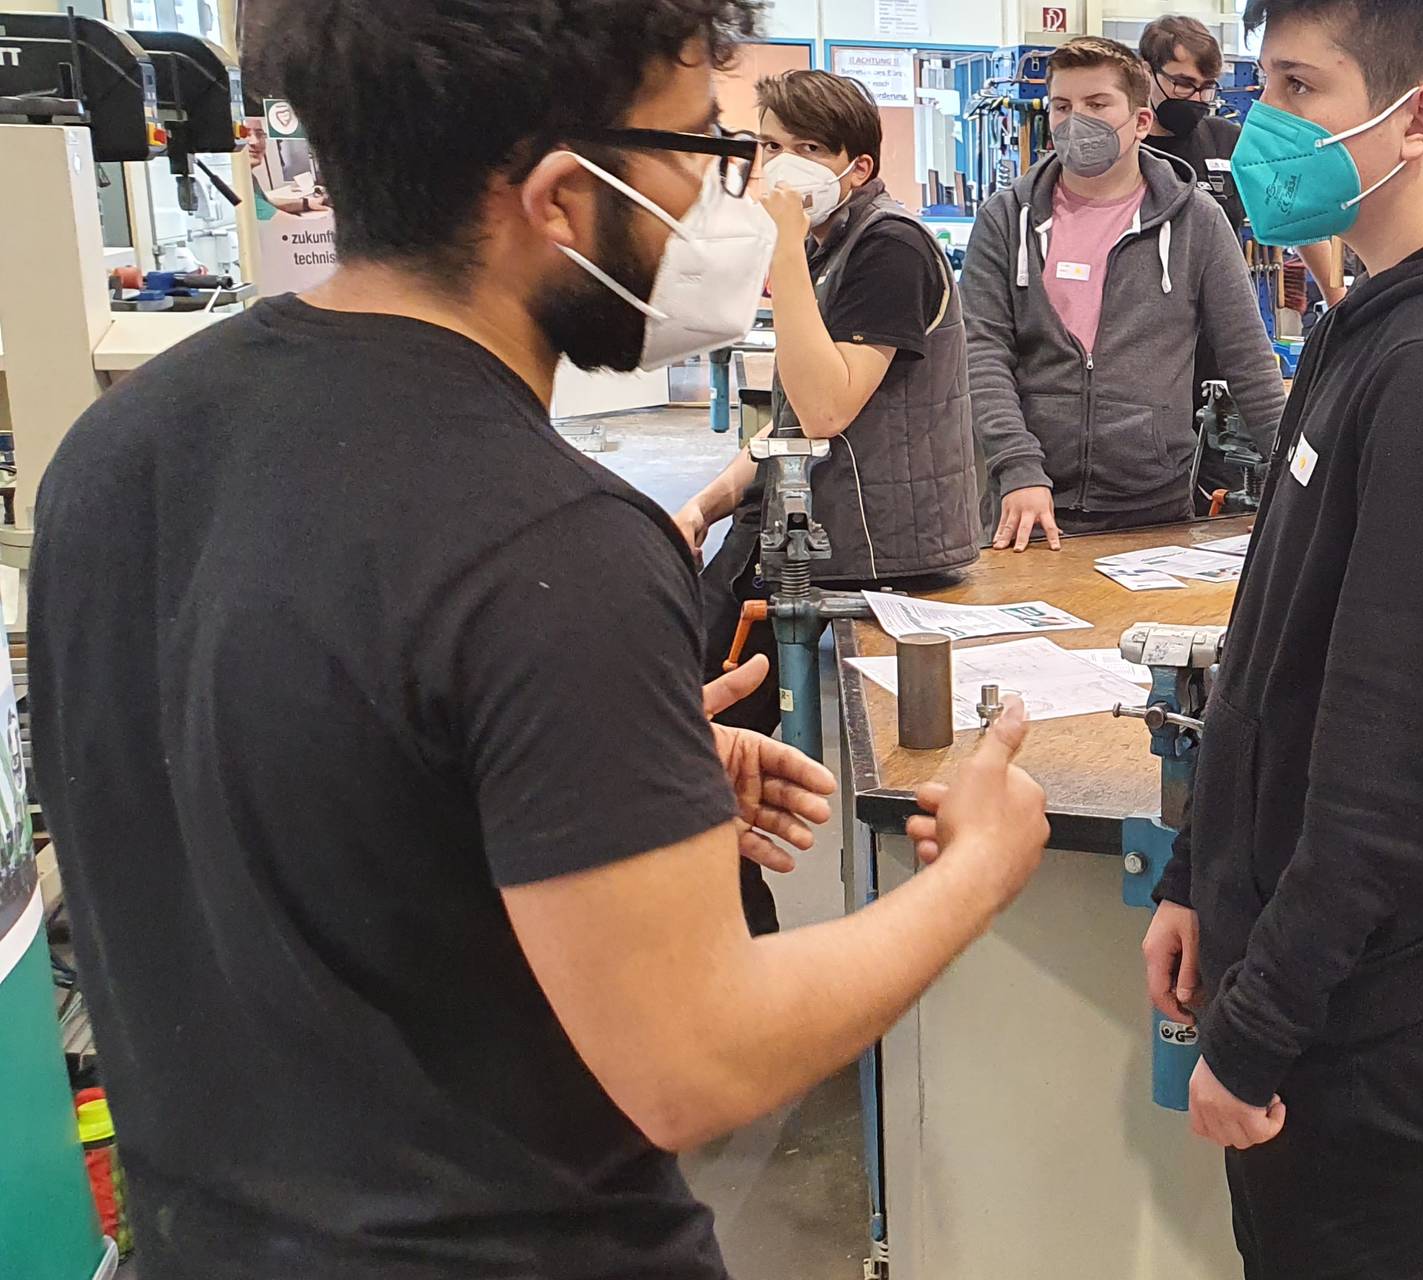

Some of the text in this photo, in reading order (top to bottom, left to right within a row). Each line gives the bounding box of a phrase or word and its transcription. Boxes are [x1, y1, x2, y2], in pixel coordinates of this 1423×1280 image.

[855, 56, 892, 65] ACHTUNG
[294, 250, 336, 265] technis
[1175, 1025, 1197, 1042] GS
